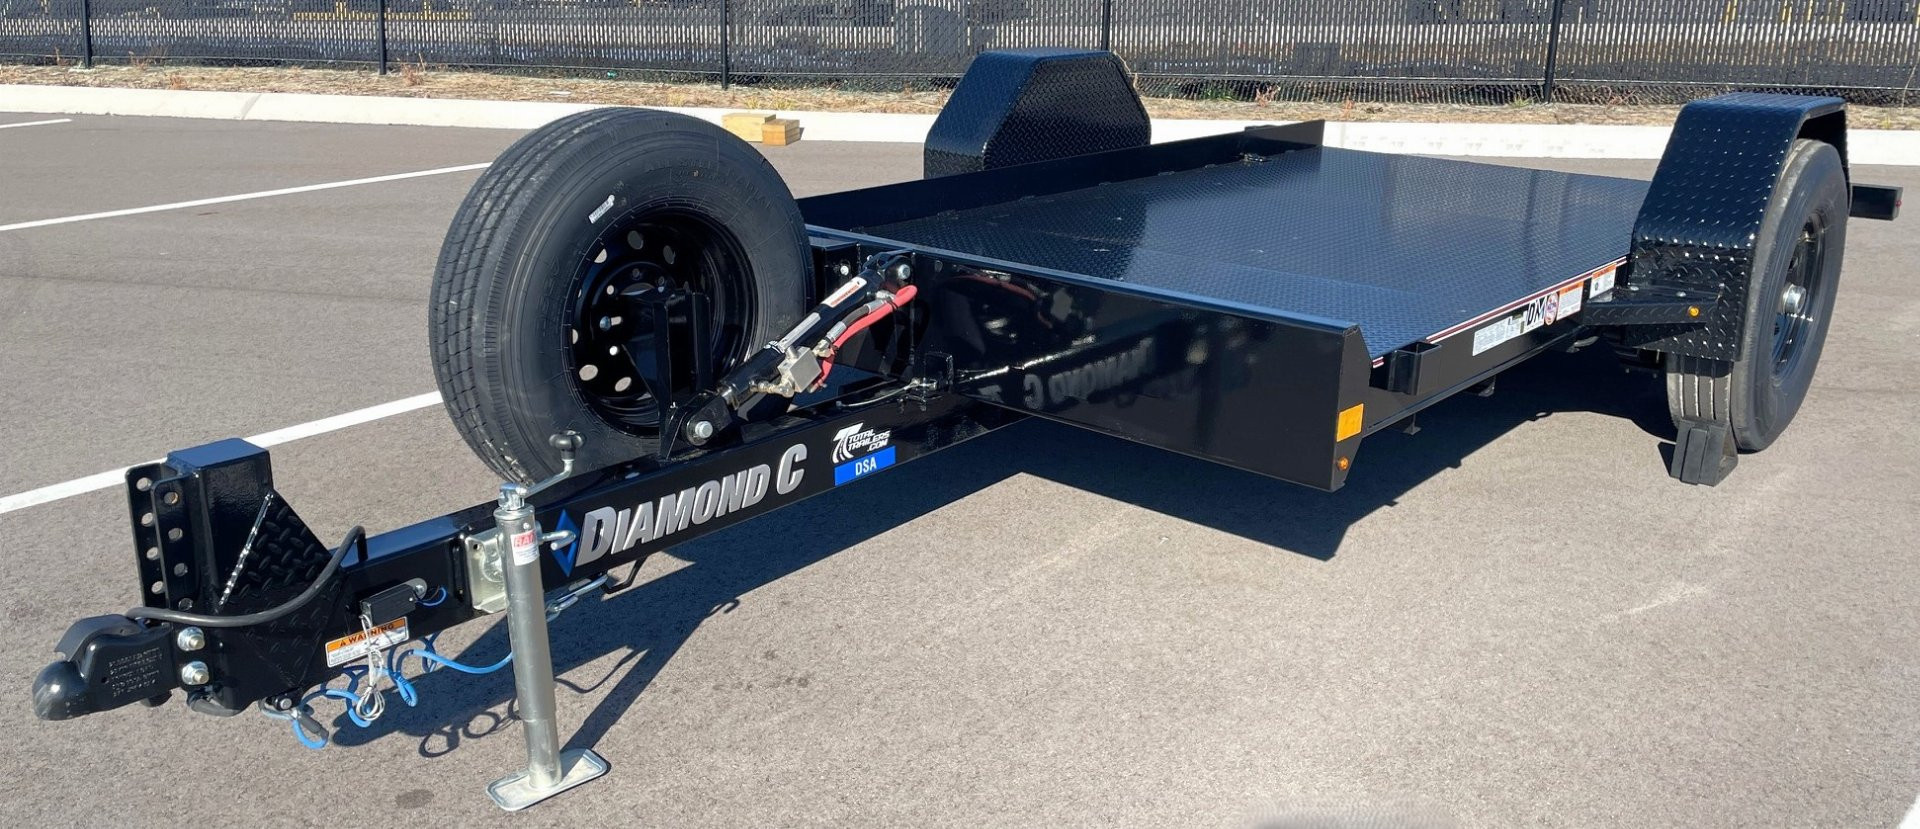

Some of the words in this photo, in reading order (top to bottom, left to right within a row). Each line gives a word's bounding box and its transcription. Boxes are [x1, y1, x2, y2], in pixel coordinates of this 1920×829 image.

[848, 429, 875, 443] TOTAL
[848, 430, 891, 452] TRAILERS
[866, 438, 889, 452] .COM
[855, 456, 877, 476] DSA
[575, 464, 771, 568] DIAMOND
[776, 443, 808, 495] C
